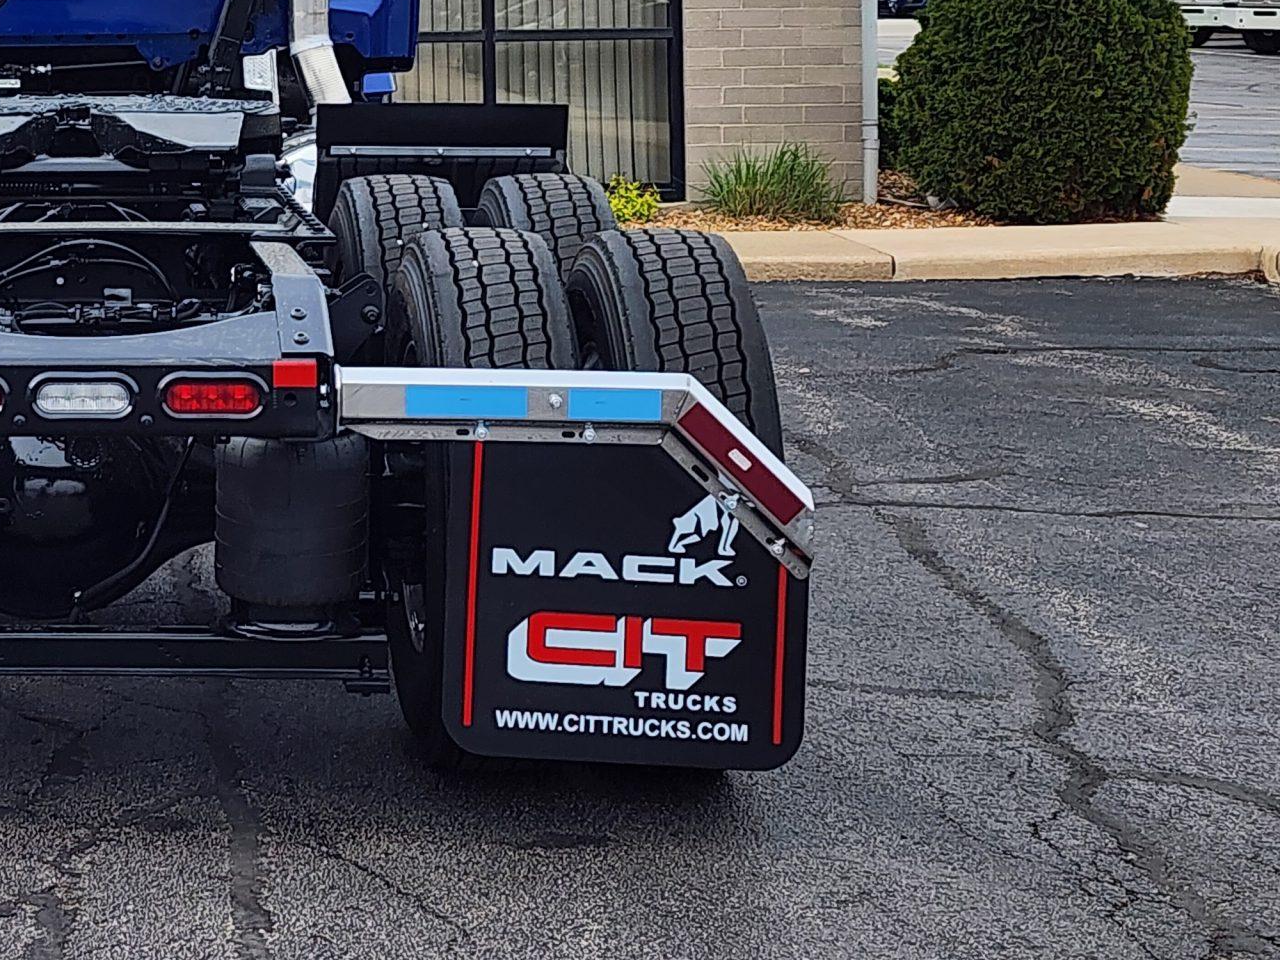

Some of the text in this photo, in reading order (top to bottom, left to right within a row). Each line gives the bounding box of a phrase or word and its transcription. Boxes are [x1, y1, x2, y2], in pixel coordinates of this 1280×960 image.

[507, 610, 742, 691] CIT
[634, 690, 737, 713] TRUCKS
[495, 709, 748, 743] WWW.CITTRUCKS.COM
